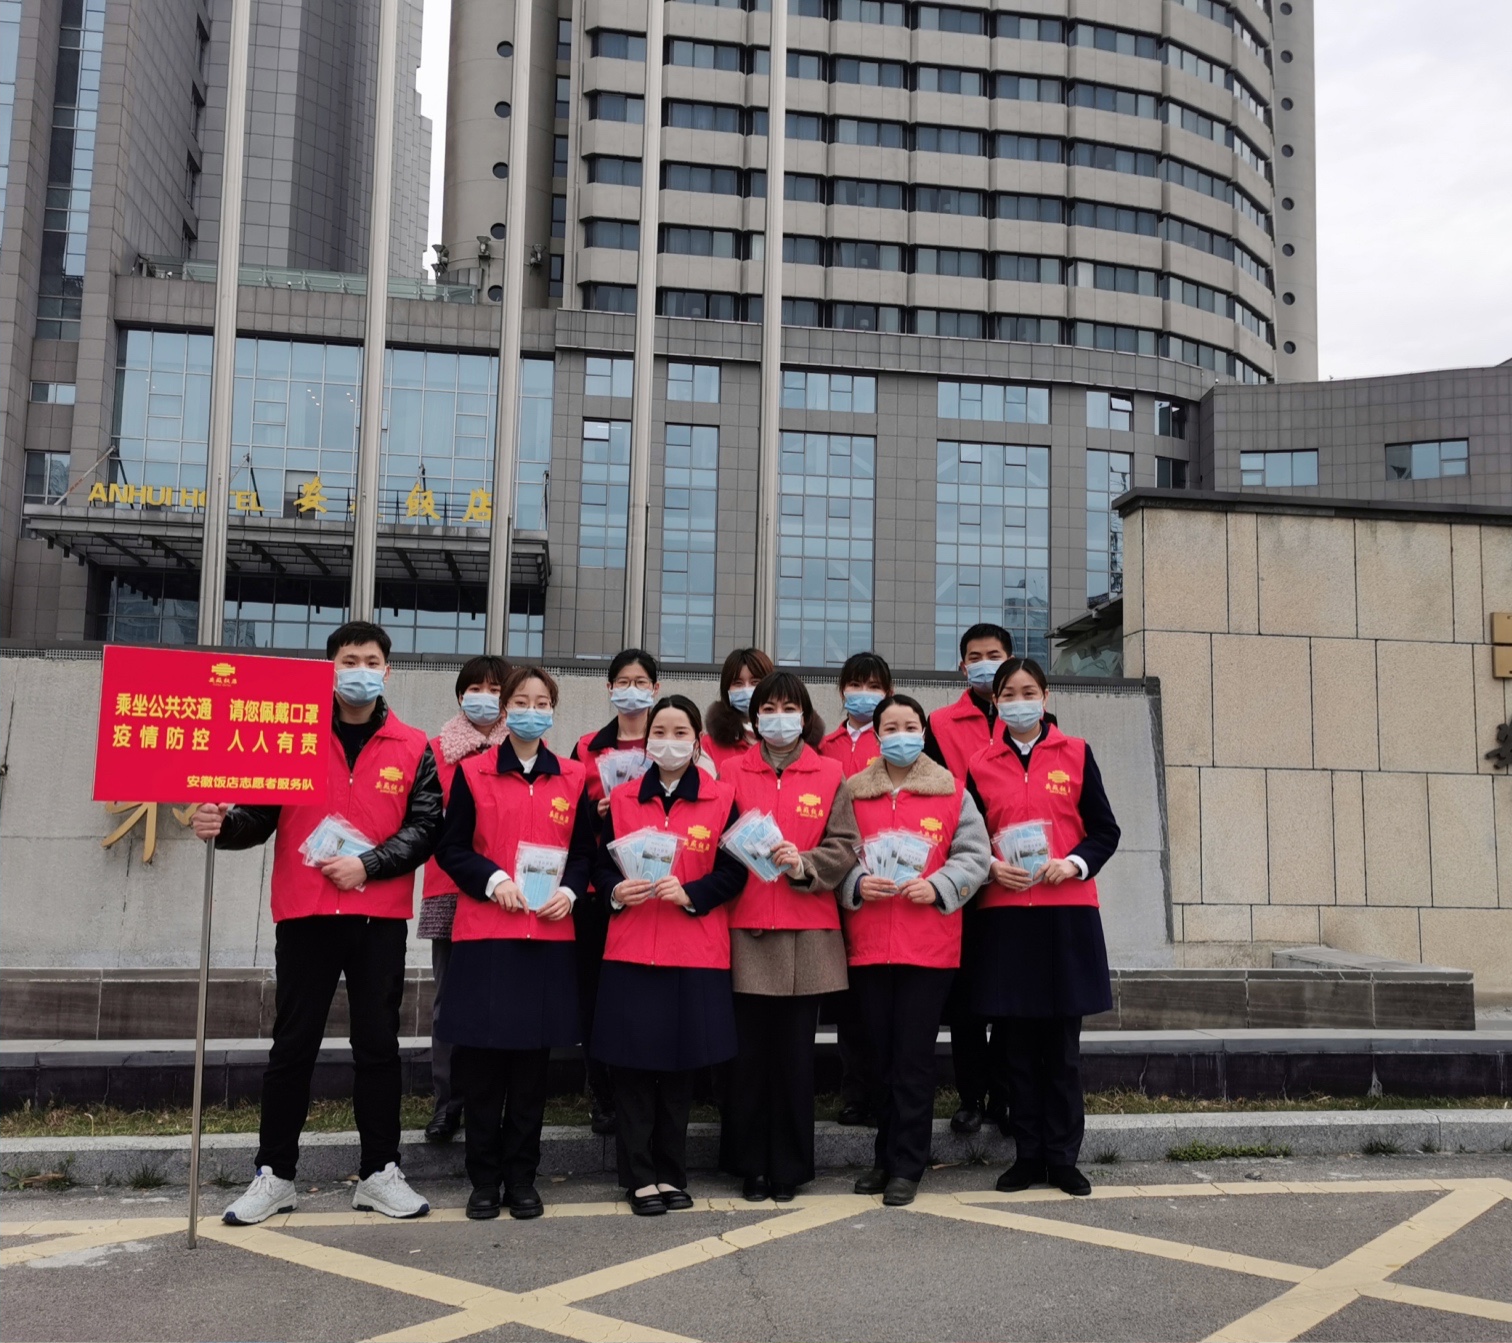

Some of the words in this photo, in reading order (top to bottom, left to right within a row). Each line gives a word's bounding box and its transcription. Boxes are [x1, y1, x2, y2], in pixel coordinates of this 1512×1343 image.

[89, 482, 173, 506] ANHUI
[180, 487, 264, 512] HEL
[294, 476, 492, 522] 安飯店
[115, 693, 212, 720] 乘坐公共交通
[229, 698, 319, 725] 请您佩戴口罩
[112, 724, 211, 751] 疫情防控
[227, 729, 318, 755] 人人有责
[186, 775, 314, 791] 安徽饭店志愿者服务队
